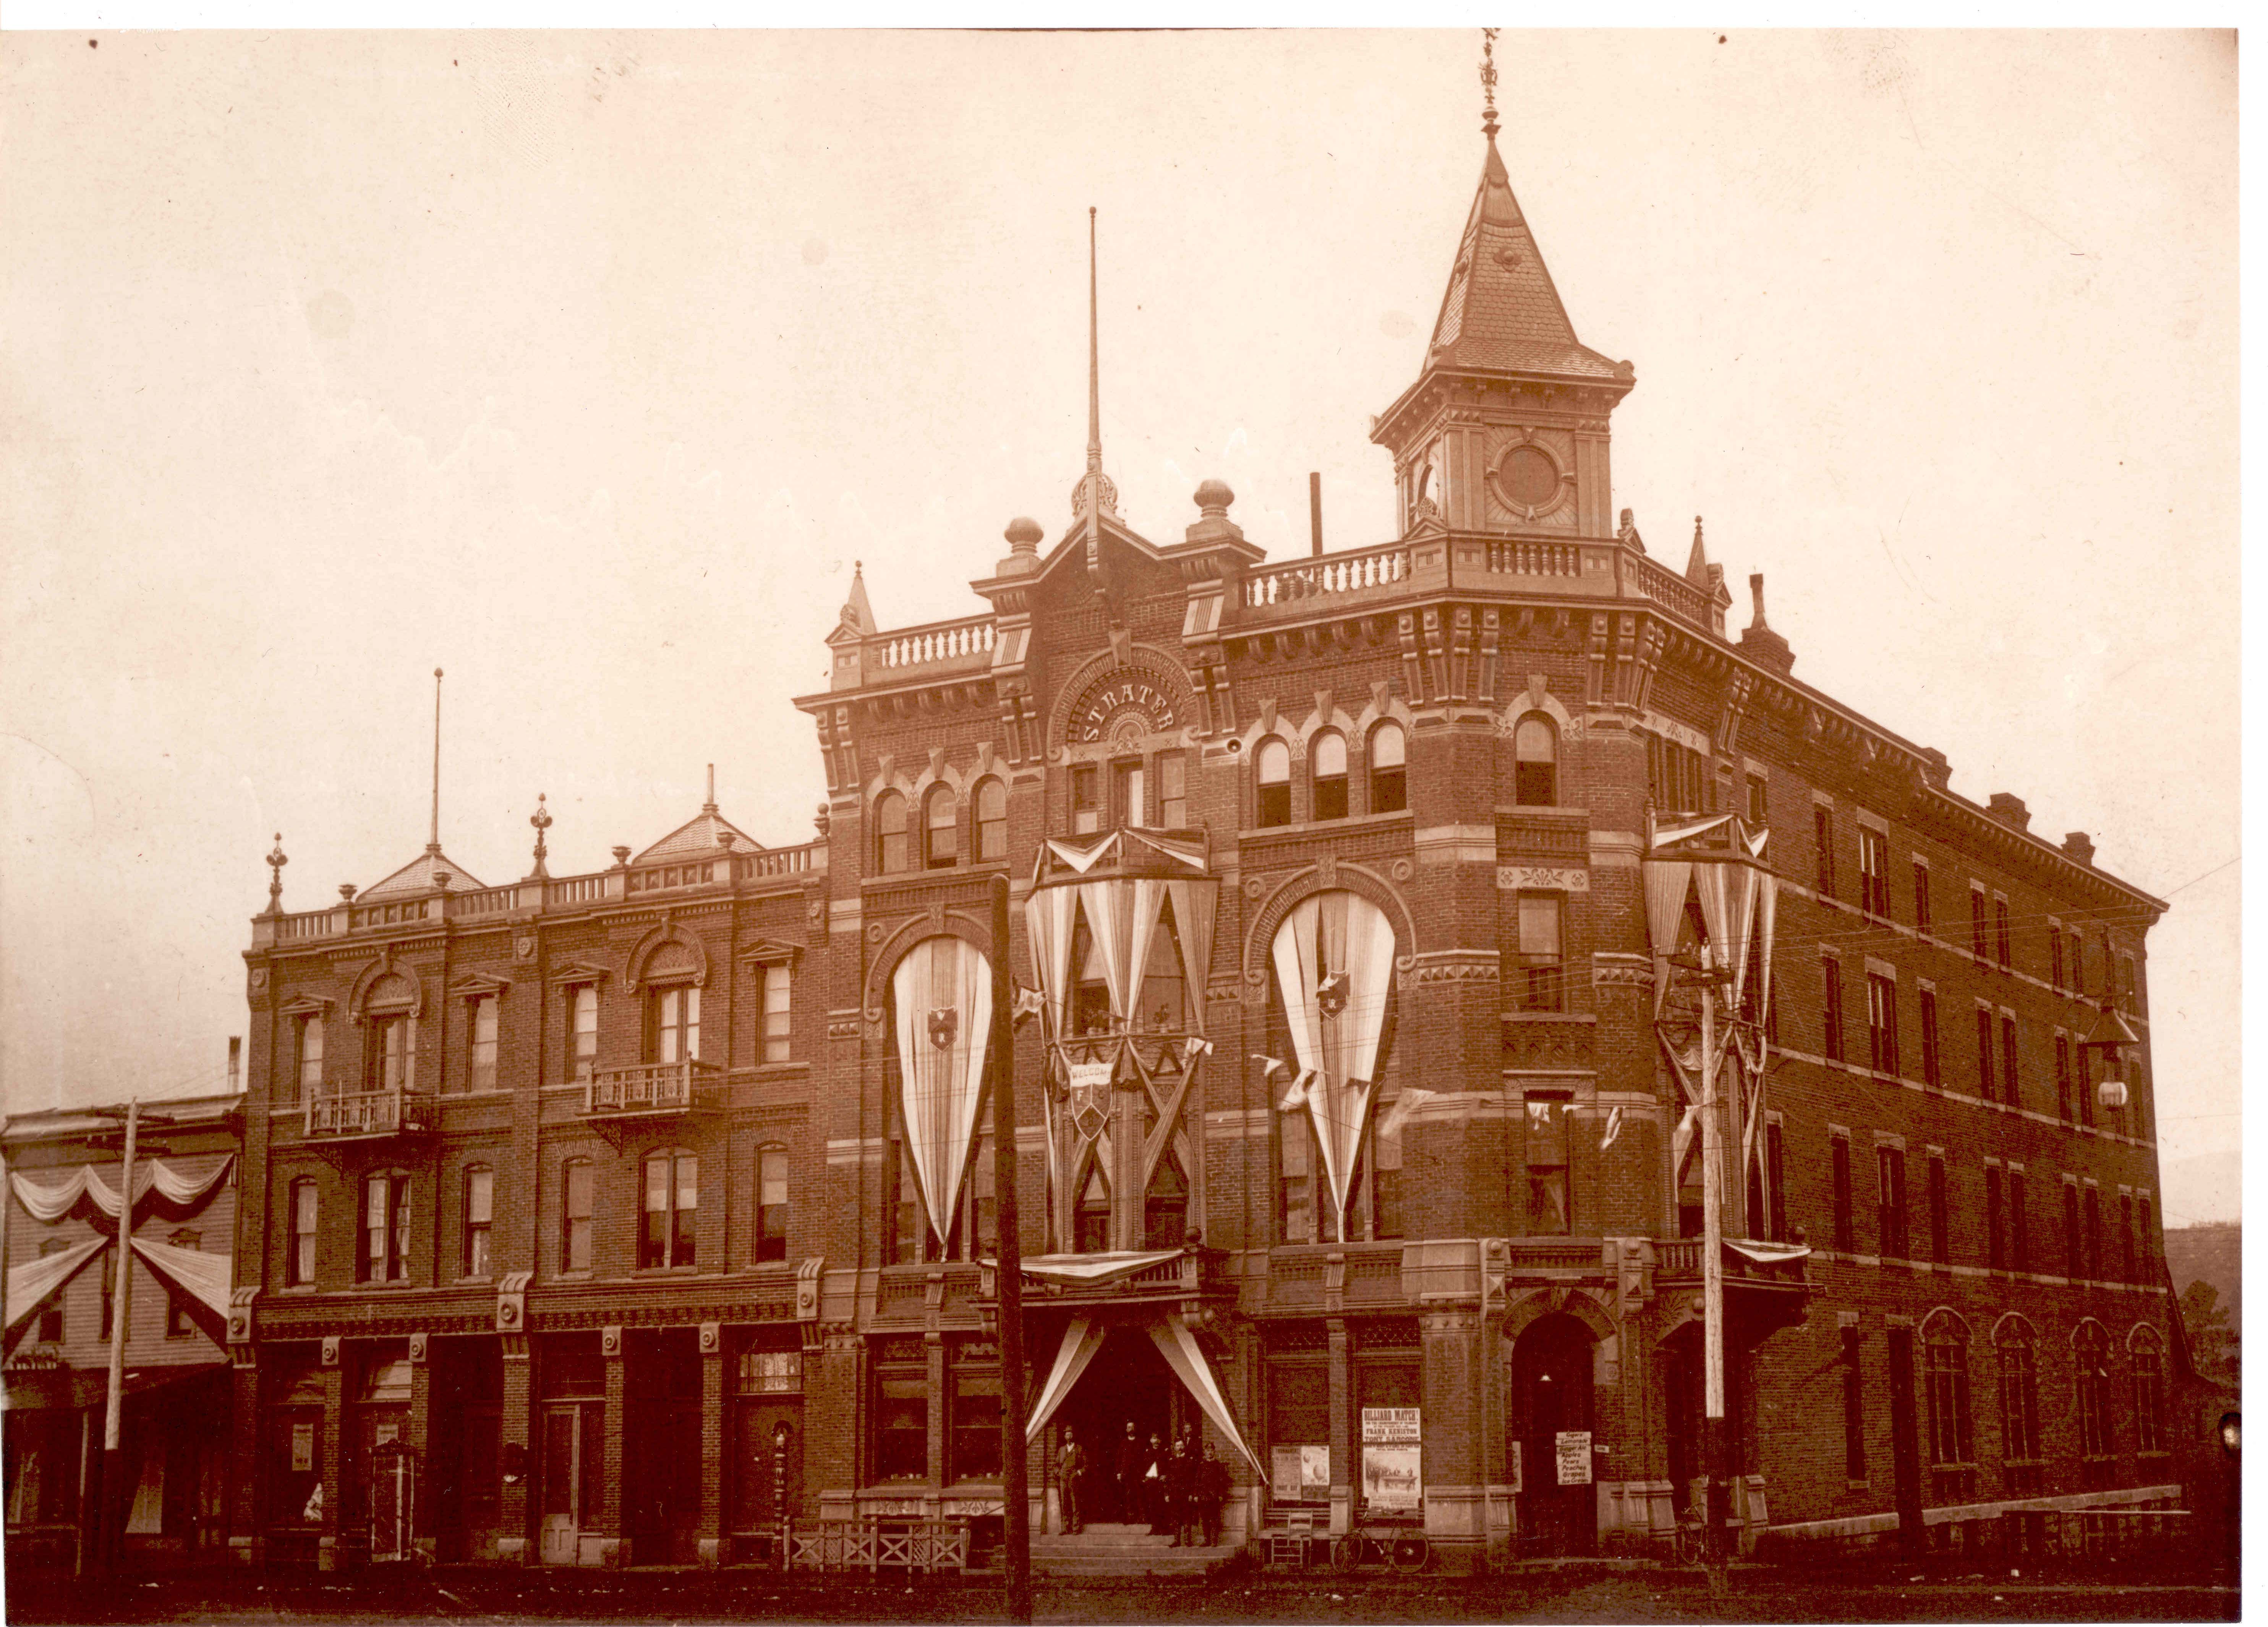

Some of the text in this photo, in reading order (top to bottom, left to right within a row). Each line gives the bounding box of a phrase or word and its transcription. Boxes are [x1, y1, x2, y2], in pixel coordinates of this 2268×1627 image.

[1084, 684, 1174, 741] STRATER
[1077, 1090, 1084, 1101] F
[1364, 1410, 1418, 1421] BILLIARD MATCH!
